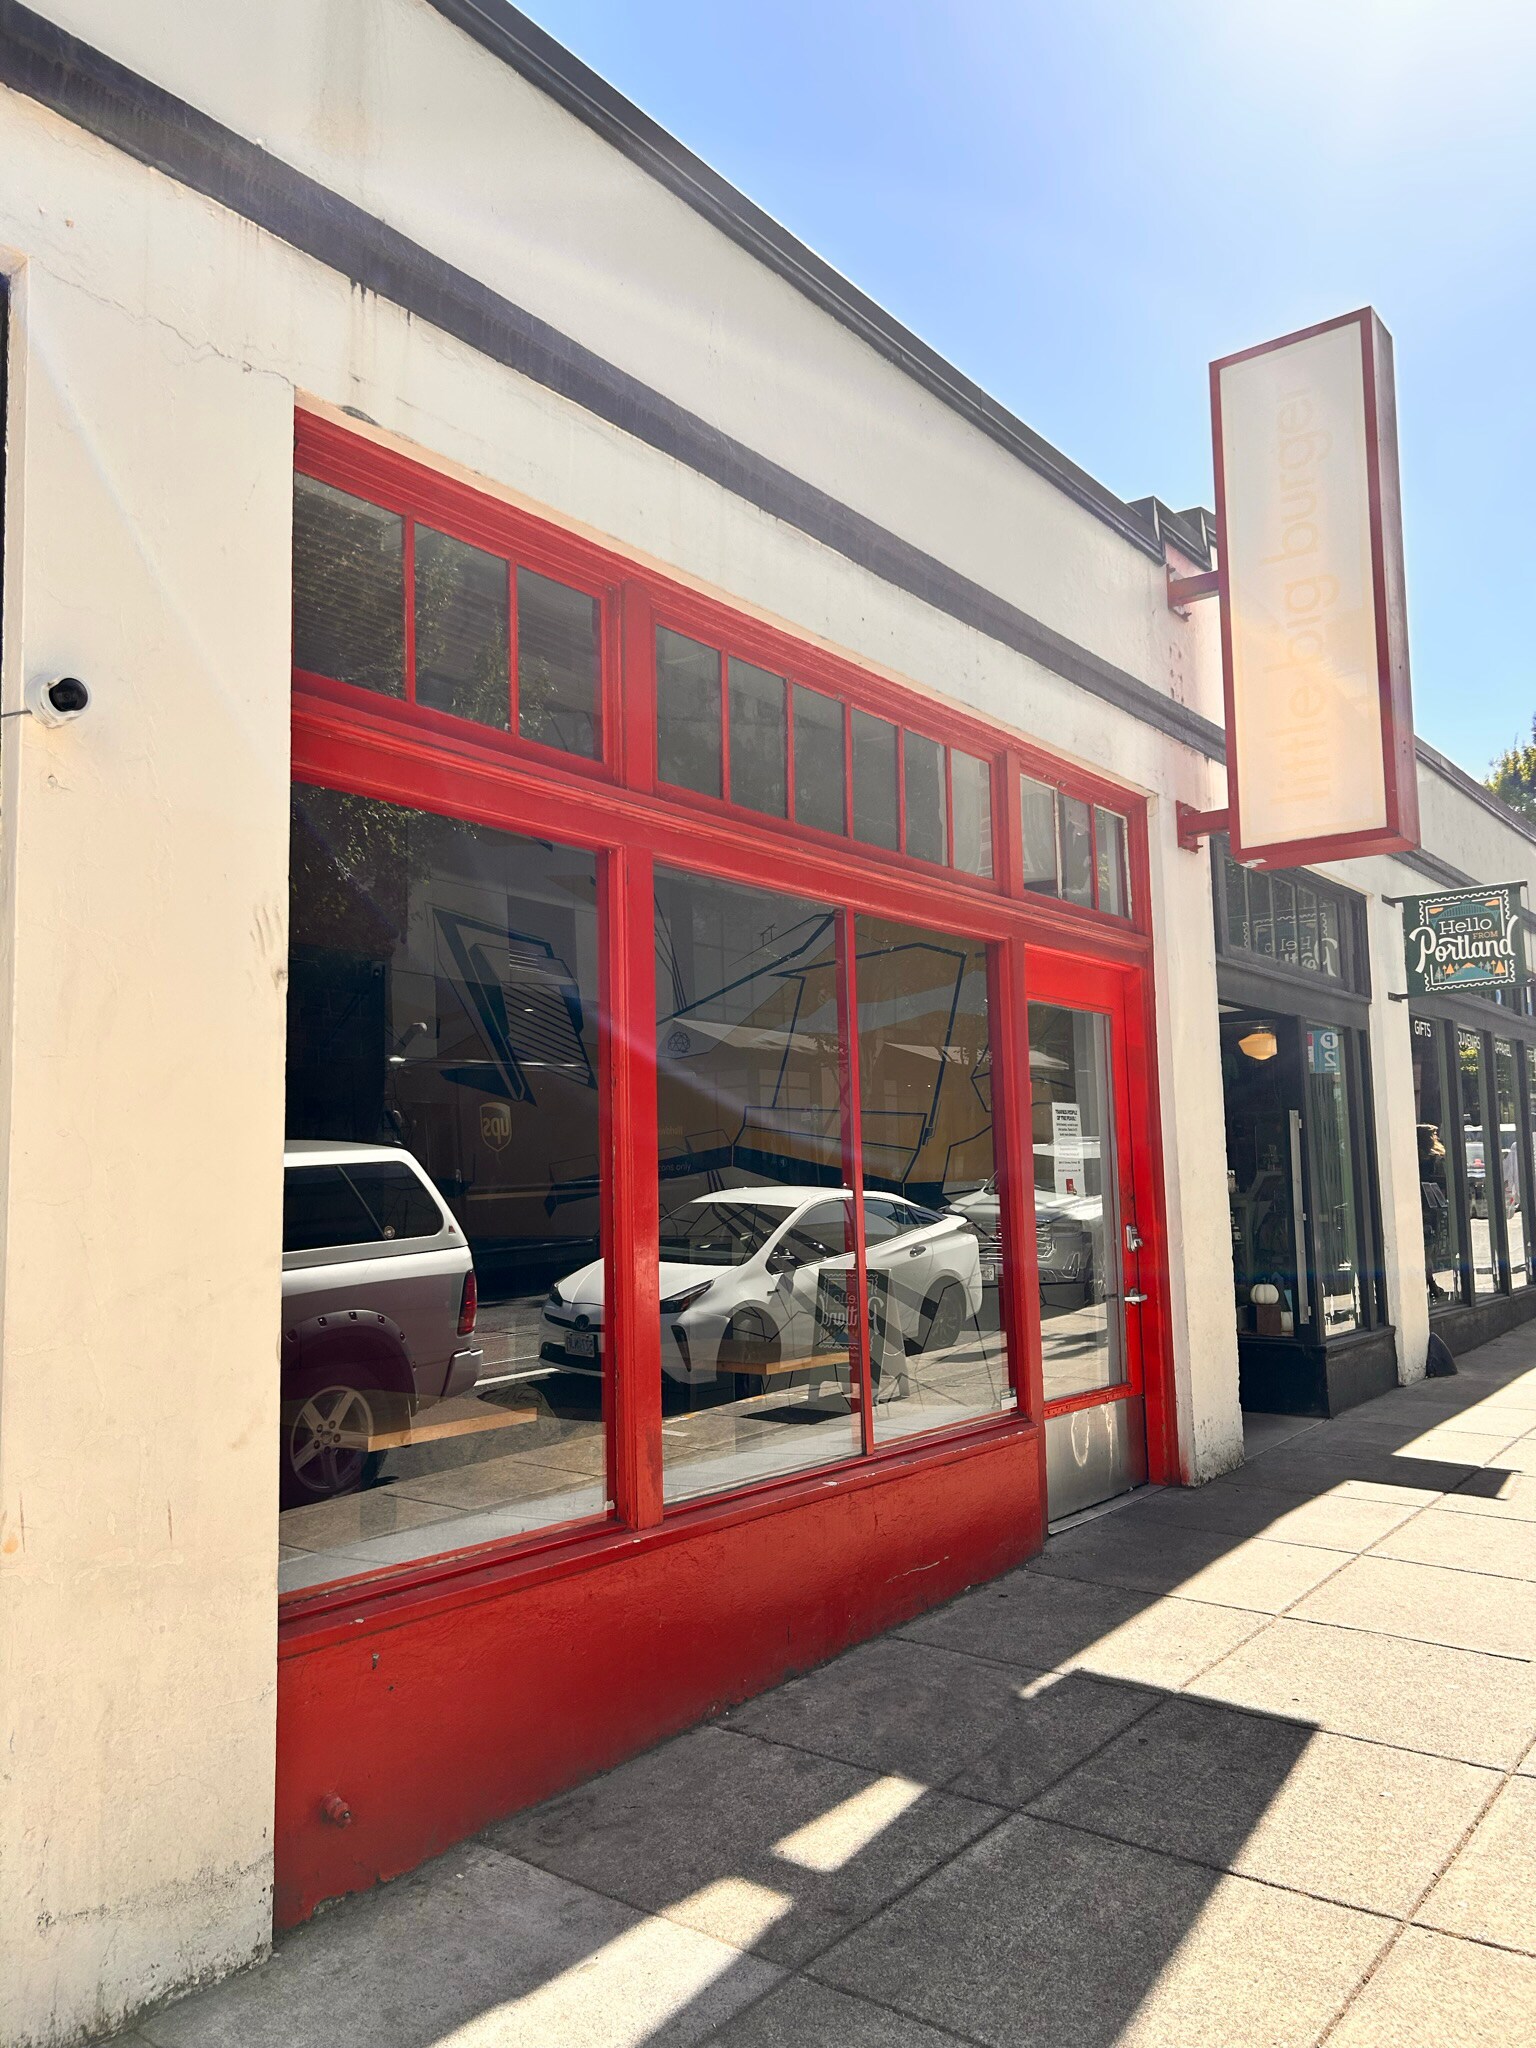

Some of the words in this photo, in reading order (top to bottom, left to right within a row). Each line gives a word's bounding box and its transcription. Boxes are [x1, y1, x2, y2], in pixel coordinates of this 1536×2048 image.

[1261, 388, 1333, 566] burger
[1263, 573, 1341, 674] big
[1266, 686, 1332, 805] little
[1408, 914, 1519, 974] Portland
[1438, 917, 1492, 935] Hello
[1472, 930, 1499, 940] FROM
[1414, 1020, 1432, 1038] GIFTS
